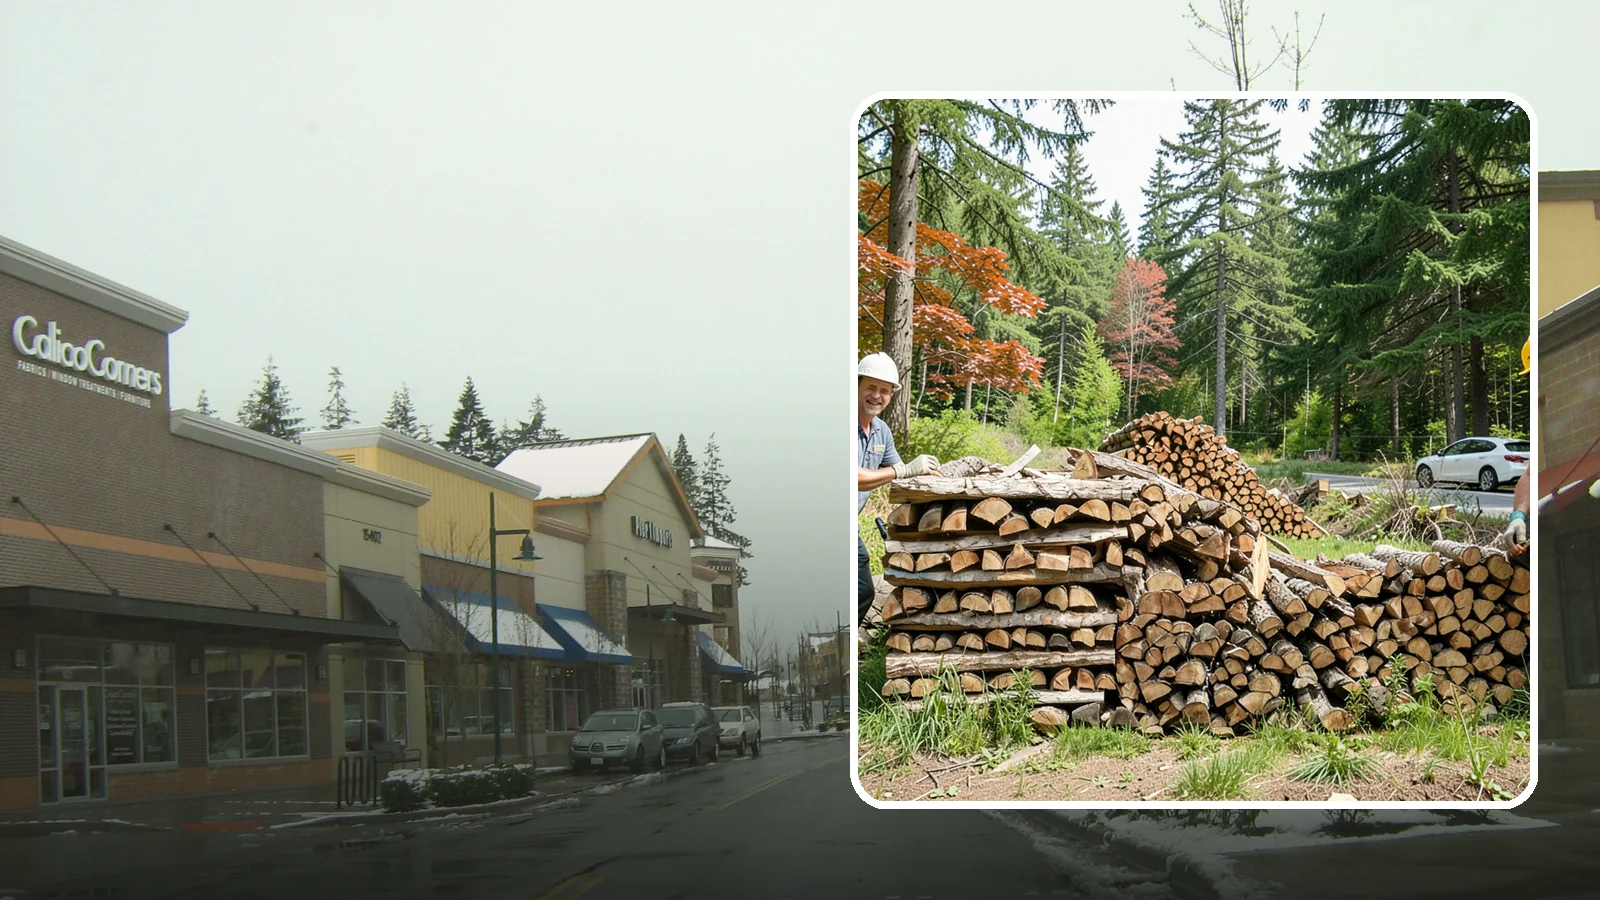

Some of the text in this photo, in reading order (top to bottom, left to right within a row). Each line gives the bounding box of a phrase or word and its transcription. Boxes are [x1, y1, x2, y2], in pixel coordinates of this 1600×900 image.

[17, 360, 151, 408] FABRICS WINDOW TREATMENTS FURNITURE
